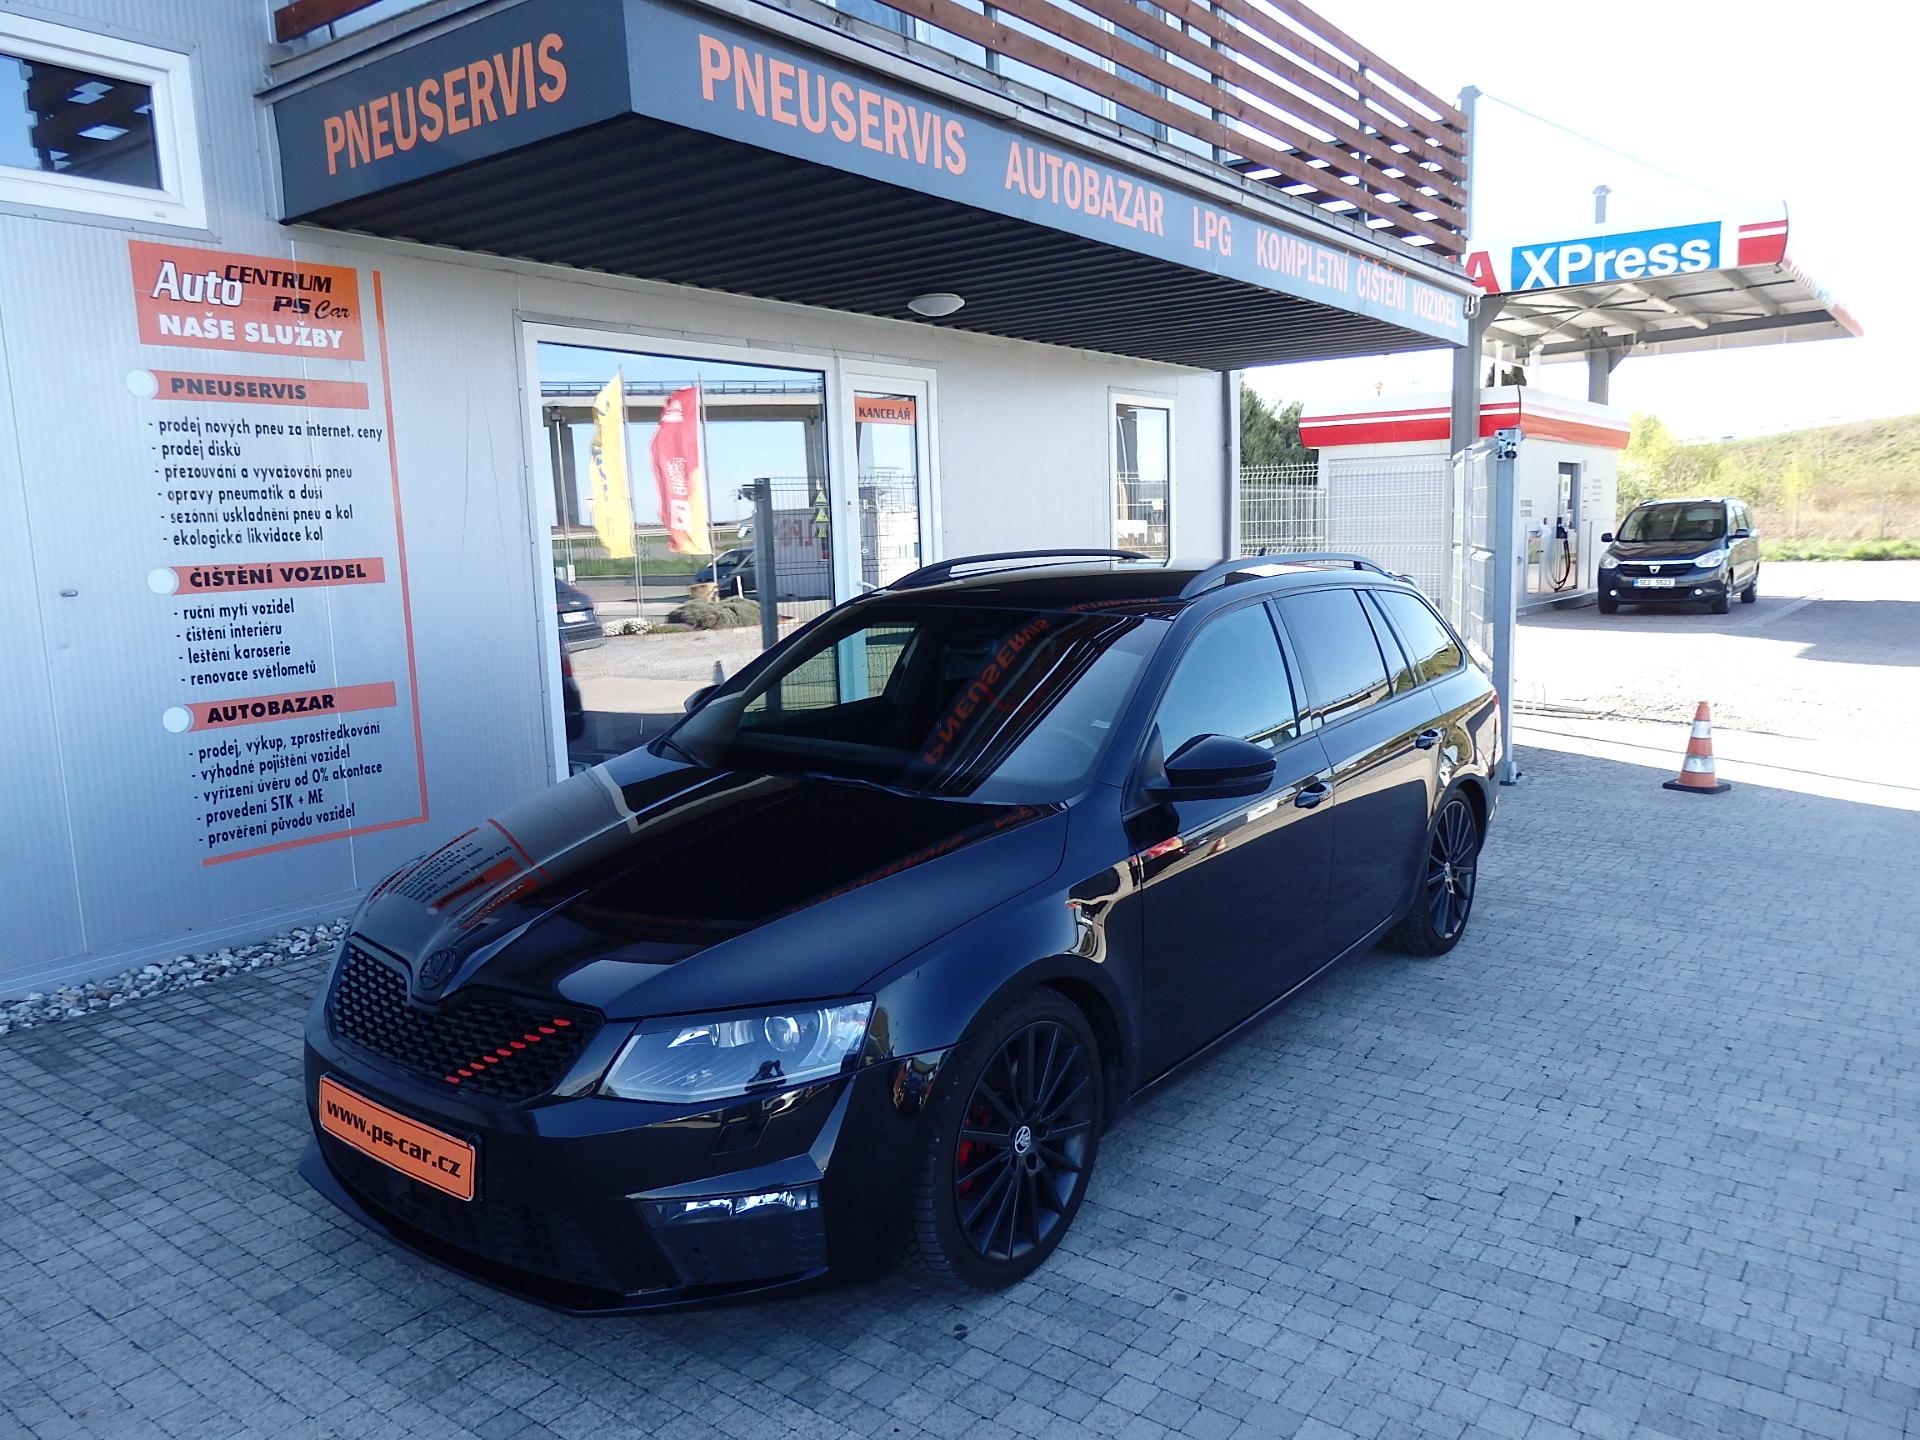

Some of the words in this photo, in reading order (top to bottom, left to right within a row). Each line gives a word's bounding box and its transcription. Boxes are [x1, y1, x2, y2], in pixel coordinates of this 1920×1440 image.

[323, 33, 568, 175] PNEUSERVIS
[699, 33, 968, 175] PNEUSERVIS
[1005, 141, 1164, 236] AUTOBAZAR
[1193, 206, 1232, 257] LPG
[1256, 228, 1349, 293] KOMPLETNÍ
[1413, 284, 1458, 327] VOZIDEL
[1519, 238, 1712, 290] XPress
[152, 260, 243, 307] Auto
[225, 264, 332, 293] CENTRUM
[273, 295, 311, 315] PS
[314, 300, 350, 320] Car
[159, 312, 235, 341] NAŠE
[245, 320, 344, 349] SLUŽBY
[171, 377, 307, 400] PNEUSERVIS
[858, 406, 911, 420] KANCELÁŘ
[159, 416, 201, 437] prodej
[205, 418, 251, 438] nových
[255, 424, 284, 438] pneu
[288, 425, 302, 436] za
[306, 421, 354, 437] internet.
[357, 428, 382, 442] ceny
[162, 439, 204, 460] prodej
[241, 467, 248, 478] a
[326, 468, 352, 482] pneu
[168, 490, 213, 505] opravy
[218, 484, 284, 504] pneumatik
[289, 489, 295, 499] a
[293, 510, 321, 524] pneu
[325, 510, 332, 519] a
[336, 504, 353, 519] kol
[173, 527, 242, 549] ekologická
[247, 526, 301, 543] likvidace
[305, 526, 323, 541] kol
[190, 563, 273, 587] ČIŠTĚNÍ
[280, 564, 367, 582] VOZIDEL
[184, 599, 215, 619] ruční
[219, 597, 248, 620] mytí
[252, 597, 294, 615] vozidel
[186, 625, 226, 641] čištění
[230, 621, 282, 638] interiéru
[188, 647, 230, 664] leštění
[234, 640, 291, 660] karoserie
[191, 670, 248, 685] renovace
[253, 660, 316, 680] světlometů
[207, 694, 335, 723] AUTOBAZAR
[199, 739, 242, 763] prodej,
[246, 735, 286, 755] výkup,
[201, 759, 255, 784] výhodné
[259, 751, 307, 775] pojištění
[311, 743, 350, 763] vozidel
[294, 770, 309, 787] od
[312, 766, 329, 783] 0%
[332, 763, 383, 780] akontace
[206, 799, 267, 827] provedení
[271, 793, 294, 811] STK
[308, 788, 323, 804] ME
[208, 820, 267, 848] prověření
[271, 811, 312, 836] původu
[316, 802, 356, 823] vozidel
[326, 1100, 461, 1178] www.ps-car.cz
